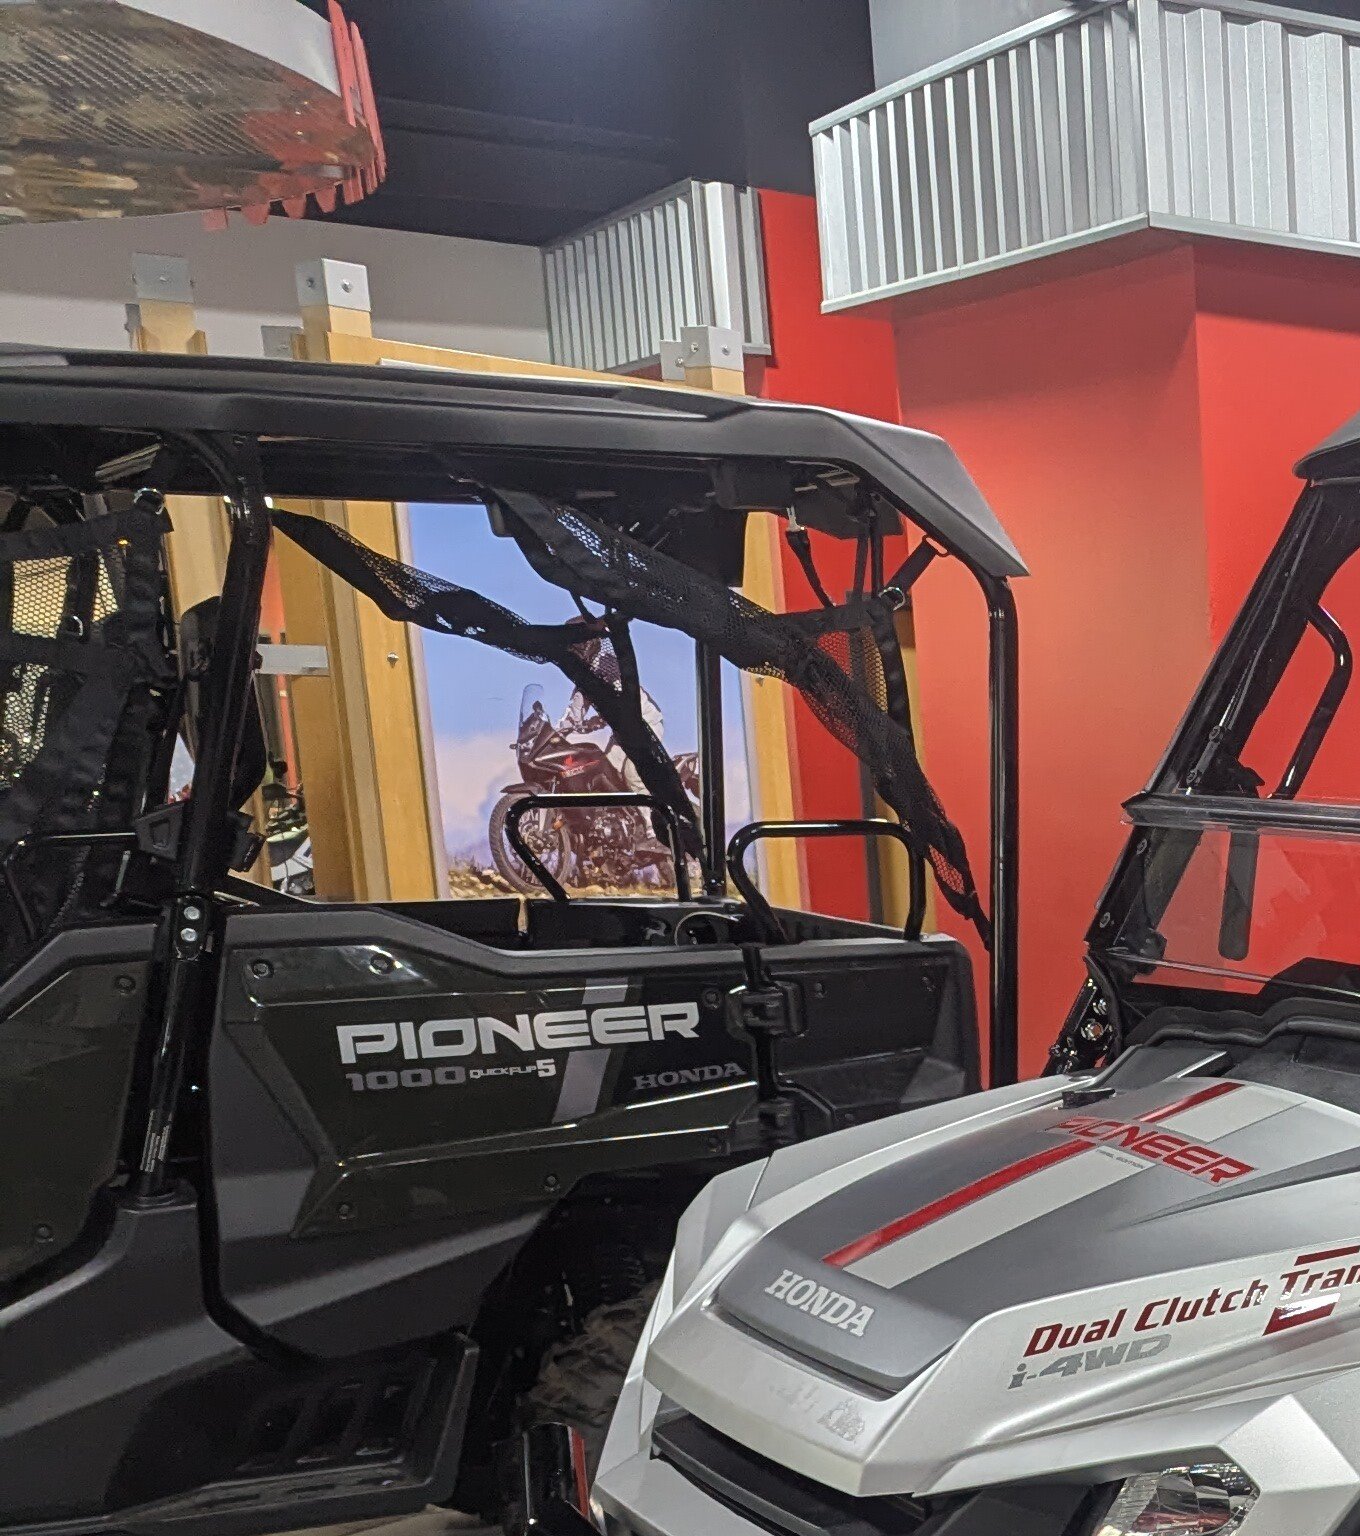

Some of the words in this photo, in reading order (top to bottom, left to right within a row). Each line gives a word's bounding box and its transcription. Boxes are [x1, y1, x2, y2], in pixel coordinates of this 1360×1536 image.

[336, 1002, 700, 1065] PIONEER
[346, 1066, 467, 1091] 1000
[633, 1062, 746, 1090] HONDA
[1044, 1115, 1256, 1183] PIONEER
[764, 1269, 875, 1337] HONDA
[1023, 1308, 1126, 1358] Dual
[1133, 1278, 1267, 1332] Clutch
[1008, 1333, 1172, 1390] i-4WD
